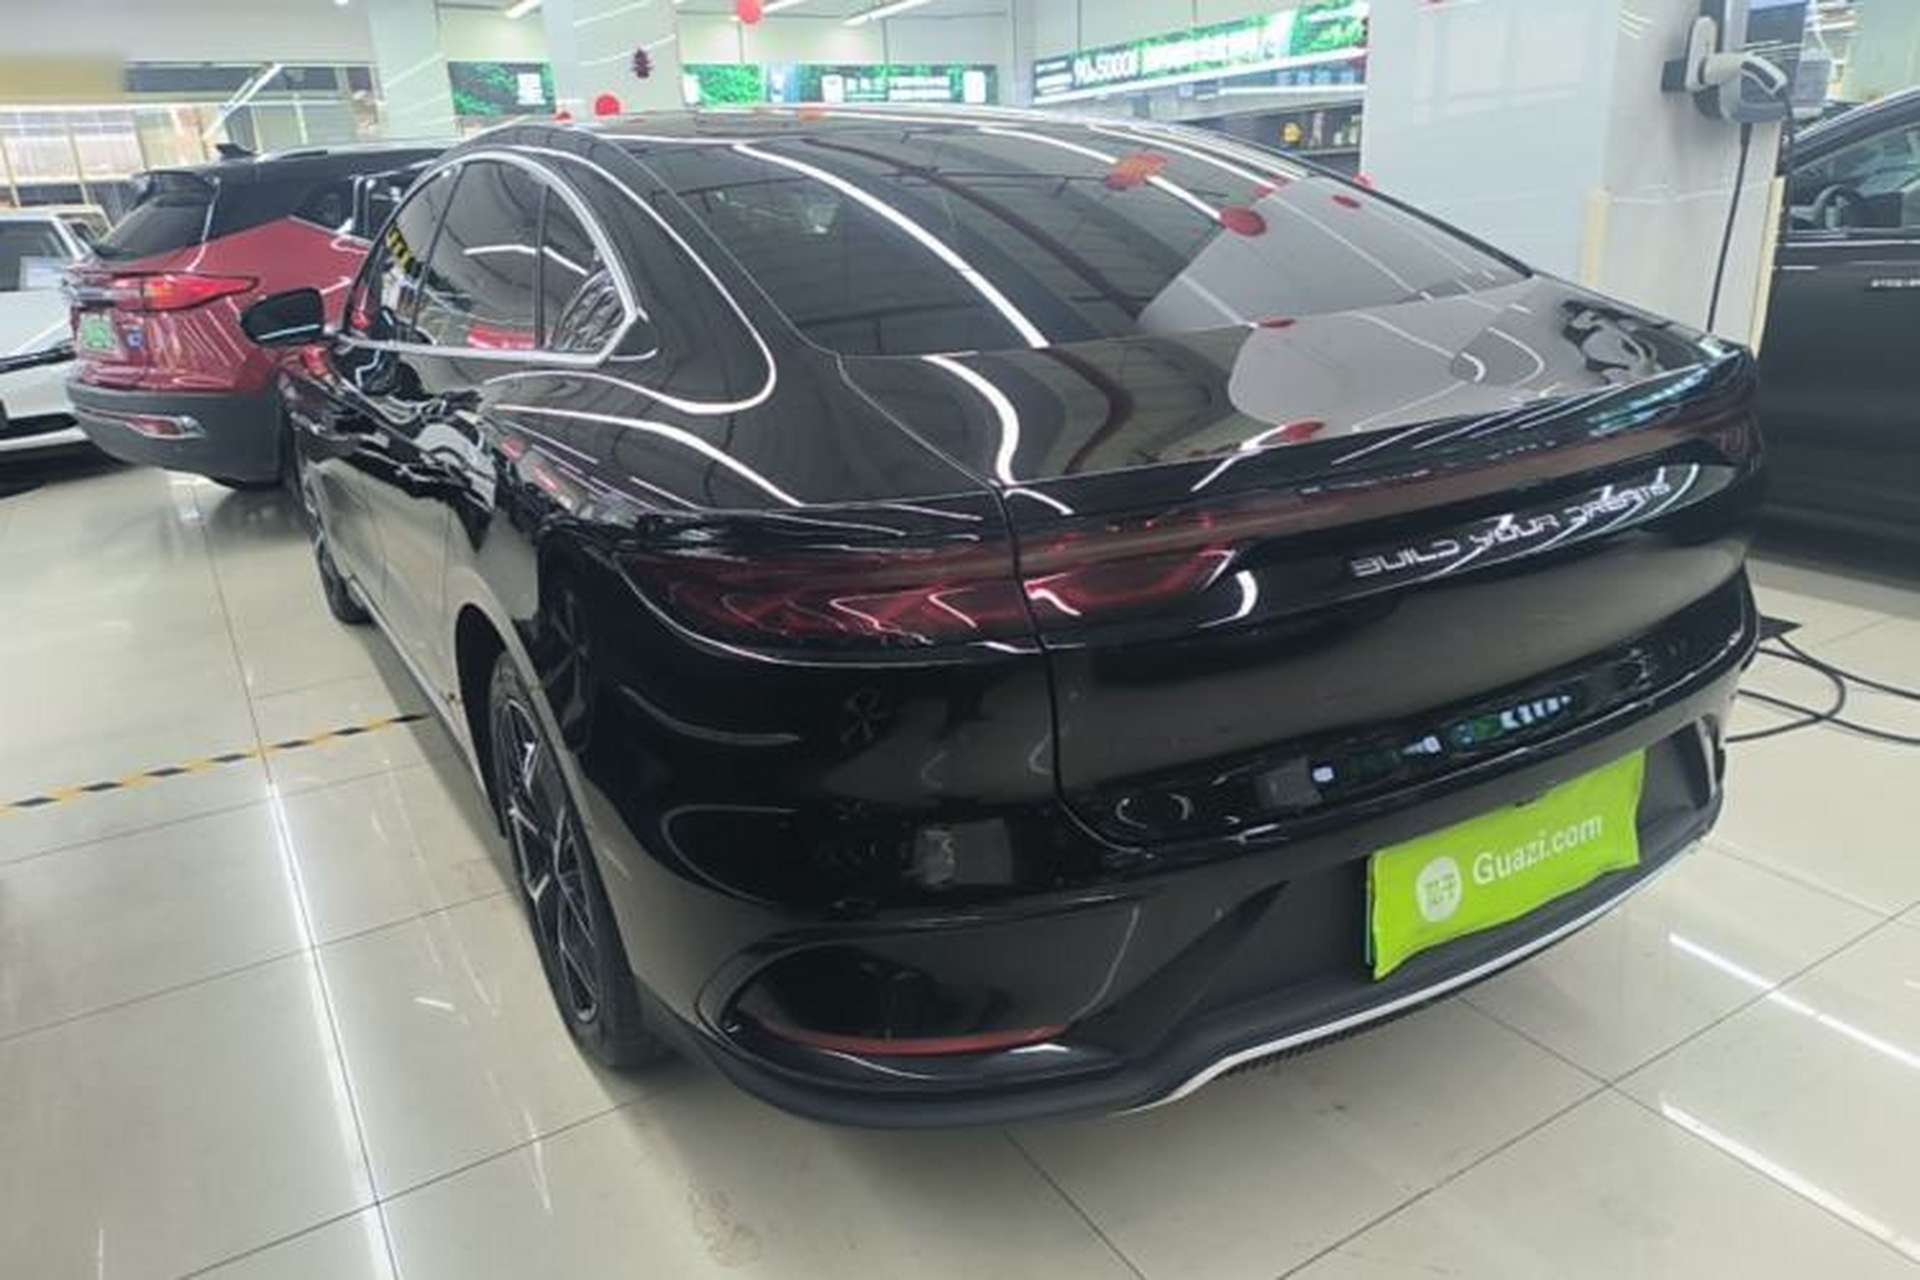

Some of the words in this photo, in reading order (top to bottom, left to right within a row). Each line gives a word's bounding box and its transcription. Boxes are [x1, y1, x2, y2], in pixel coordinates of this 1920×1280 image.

[1351, 539, 1460, 577] BUILD
[1469, 512, 1560, 549] YOUR
[1472, 815, 1603, 885] Guazi.com
